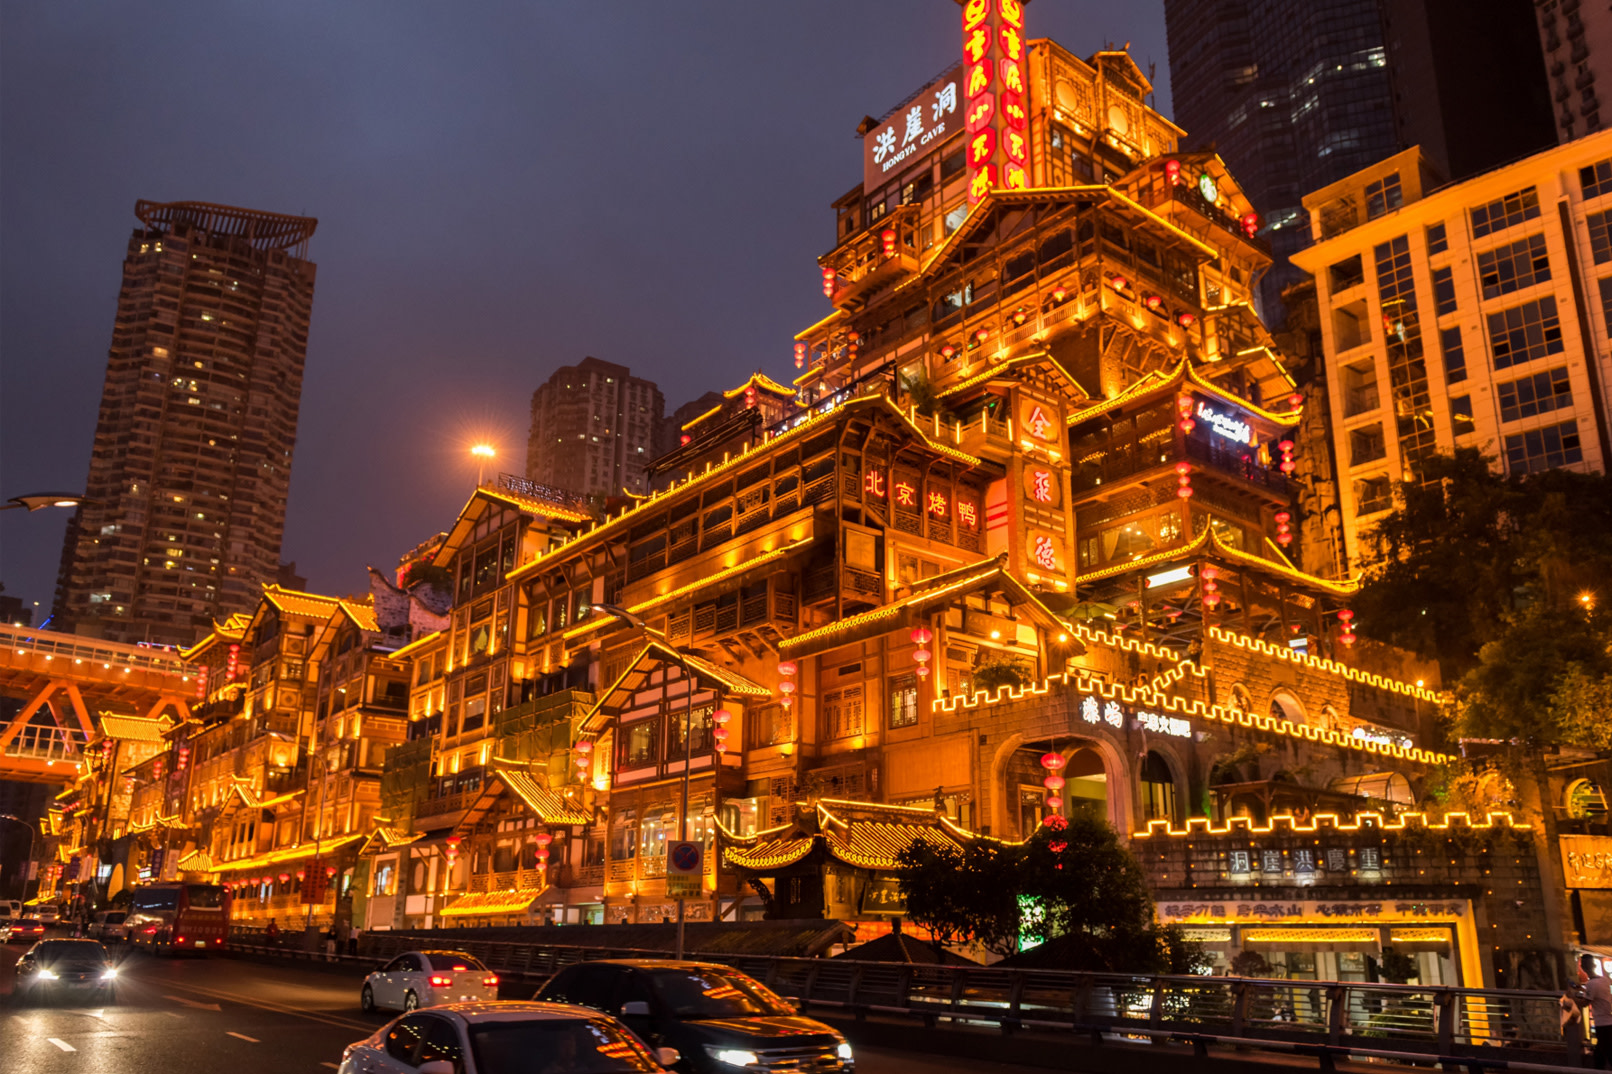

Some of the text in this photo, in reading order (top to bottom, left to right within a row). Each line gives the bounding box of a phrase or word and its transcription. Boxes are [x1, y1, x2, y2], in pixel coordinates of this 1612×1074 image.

[872, 82, 956, 163] 洪崖洞
[883, 122, 945, 172] HONGYA CAVE
[865, 470, 976, 526] 北京烤鸭
